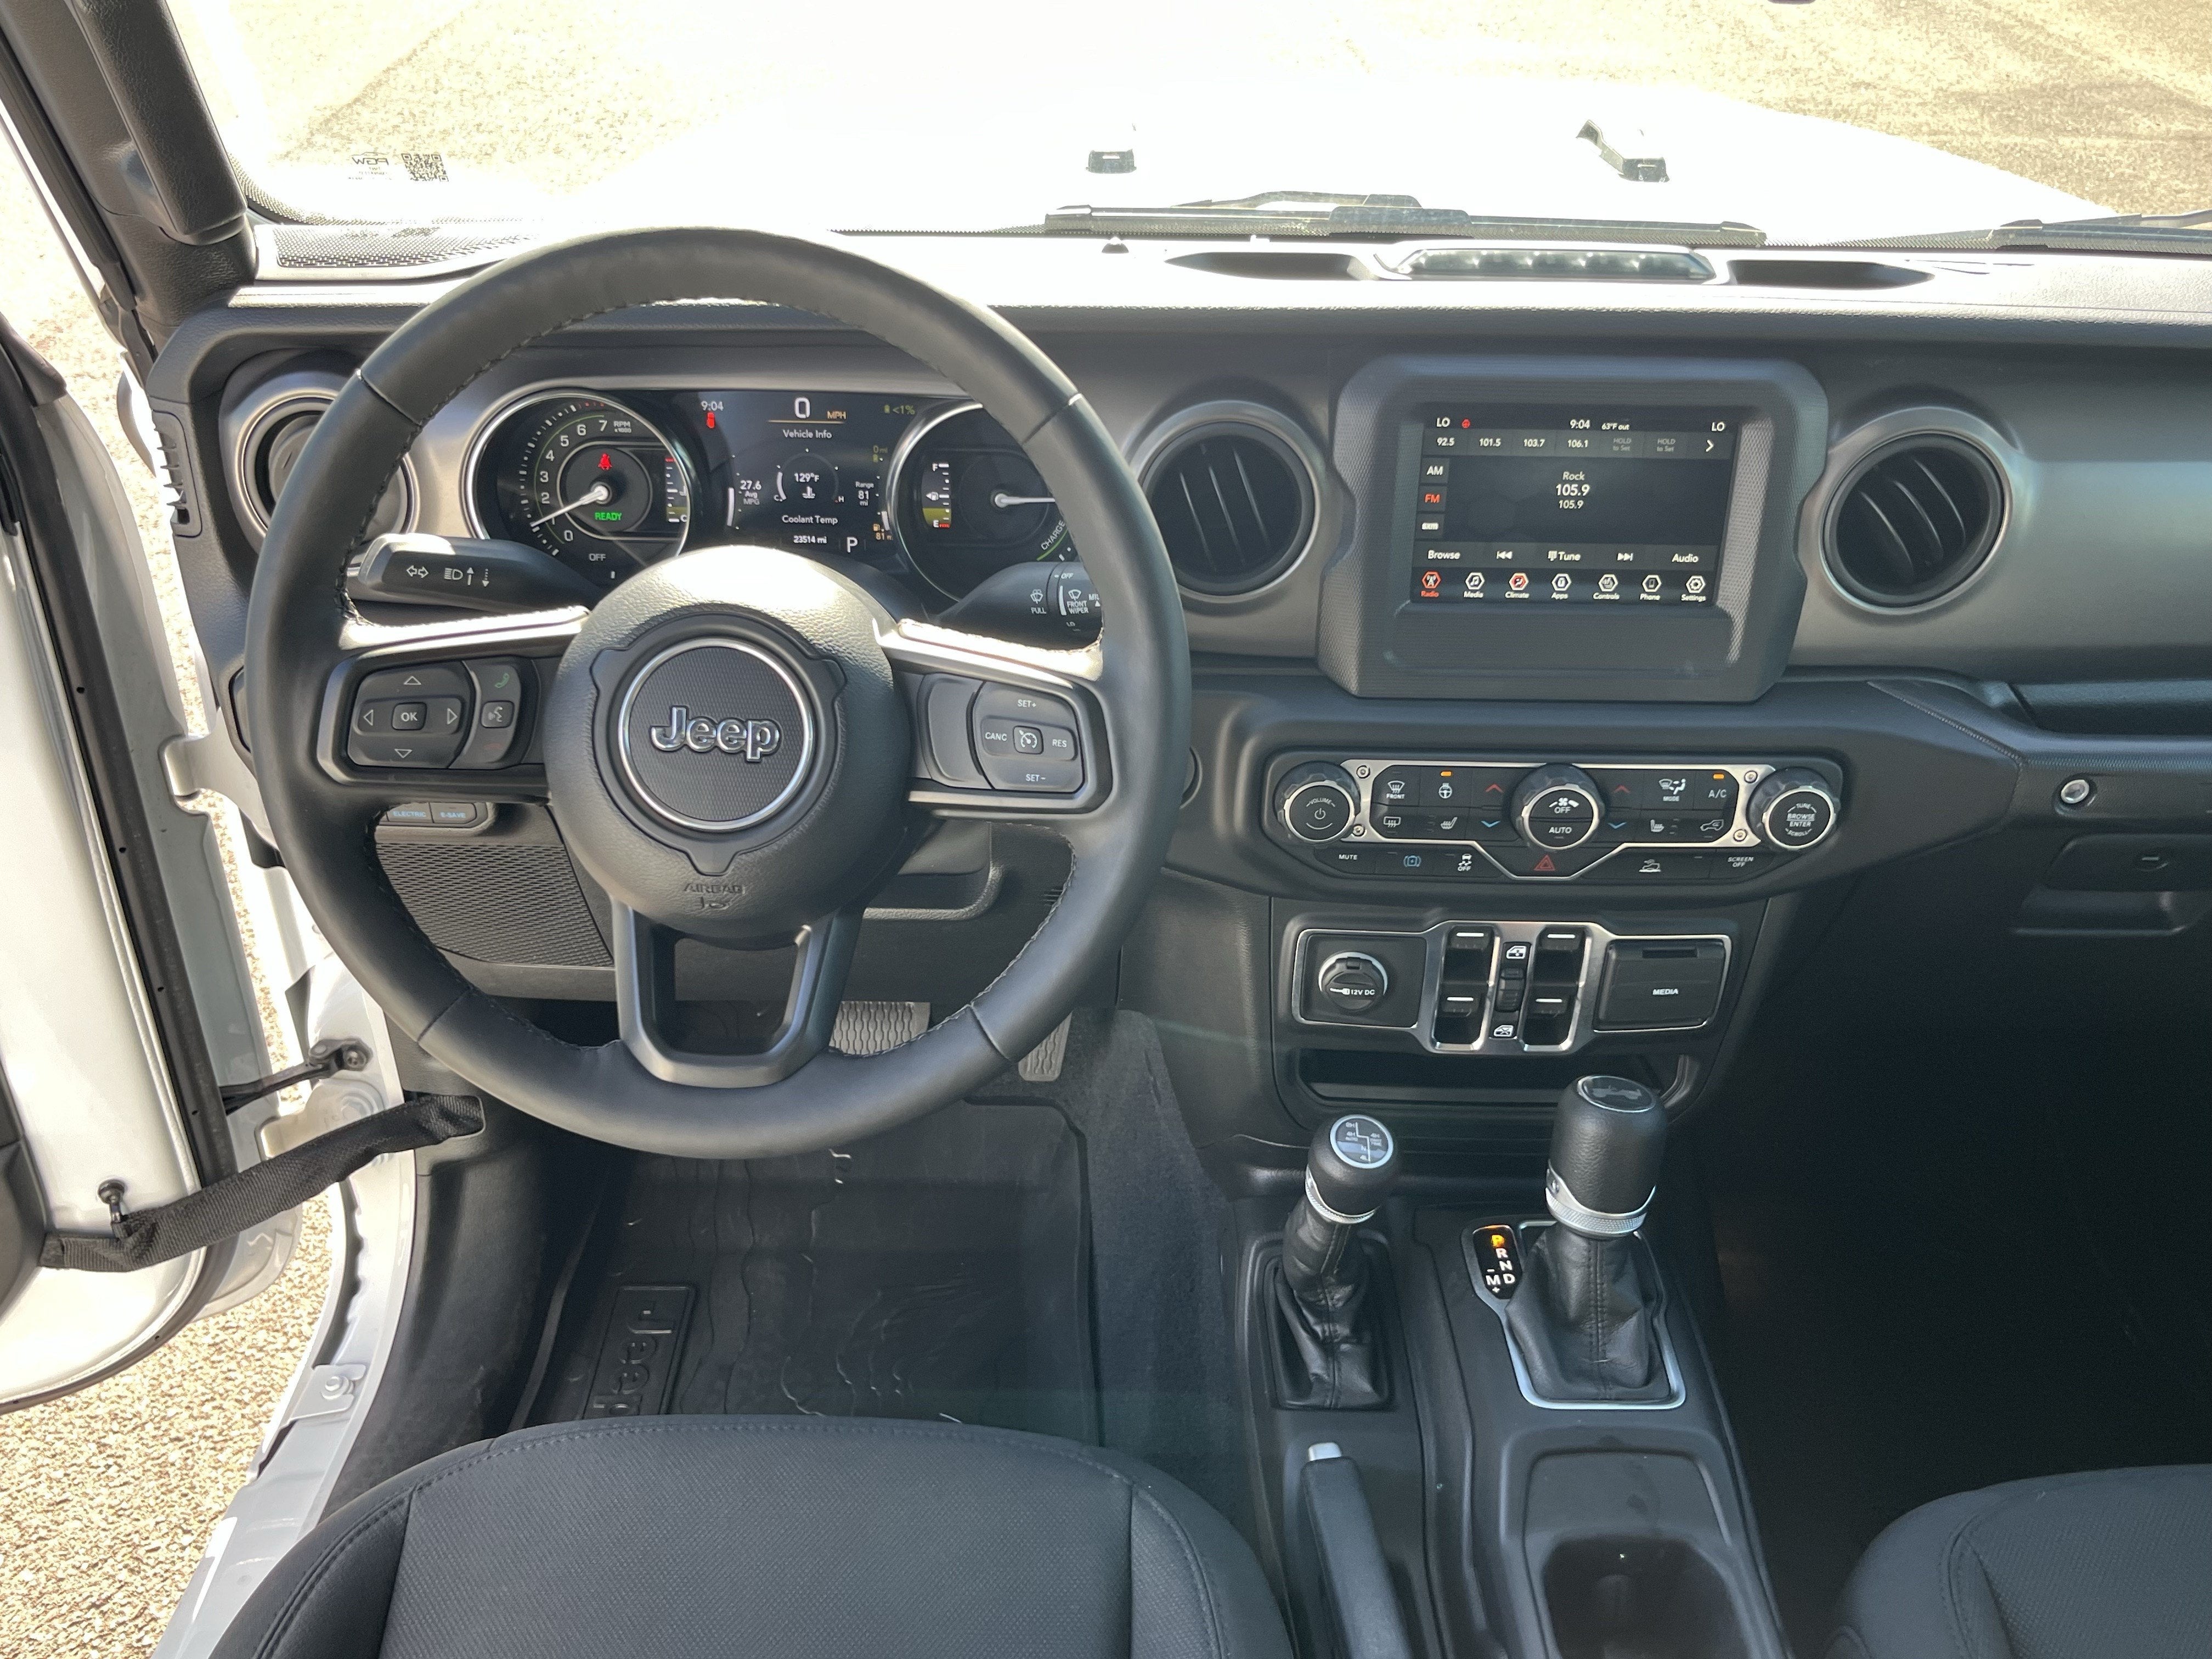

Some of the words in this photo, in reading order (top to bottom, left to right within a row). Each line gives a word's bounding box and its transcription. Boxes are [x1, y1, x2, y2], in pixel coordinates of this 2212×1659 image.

[701, 401, 724, 411] 9:04
[795, 397, 810, 419] 0
[827, 411, 847, 420] MPH
[599, 420, 608, 431] 7
[1436, 417, 1451, 427] LO
[1570, 420, 1590, 429] 9:04
[1712, 422, 1725, 432] LO
[577, 424, 586, 436] 6
[783, 430, 813, 439] Vehicle
[816, 430, 832, 439] Info
[560, 436, 569, 447] 5
[1437, 437, 1454, 447] 92.5
[1479, 438, 1501, 447] 101.5
[1523, 439, 1545, 448] 103.7
[1567, 439, 1588, 448] 106.1
[546, 450, 555, 461] 4
[1427, 466, 1443, 476] AM
[540, 471, 549, 482] 3
[1562, 472, 1585, 481] Rock
[741, 481, 761, 490] 27.6
[1556, 484, 1590, 496] 105.9
[541, 492, 550, 504] 2
[858, 490, 869, 500] 81
[1425, 494, 1441, 503] FM
[1559, 500, 1584, 509] 105.9
[595, 512, 622, 521] READY
[782, 515, 814, 524] Coolant
[815, 516, 838, 525] Temp
[564, 530, 573, 542] 0
[1041, 520, 1065, 550] CHARGE
[847, 537, 858, 553] P
[1427, 550, 1460, 560] Browse
[1558, 551, 1581, 561] Tune
[1672, 554, 1699, 563] Audio
[1681, 594, 1706, 602] Settings
[400, 712, 417, 722] OK
[651, 706, 781, 762] Jeep
[985, 732, 1007, 741] CANC
[1052, 739, 1067, 748] RES
[1708, 788, 1727, 798] A/C
[1491, 1235, 1504, 1247] P
[1496, 1248, 1508, 1259] R
[1499, 1260, 1513, 1271] N
[1486, 1274, 1500, 1286] M
[1503, 1273, 1515, 1284] D
